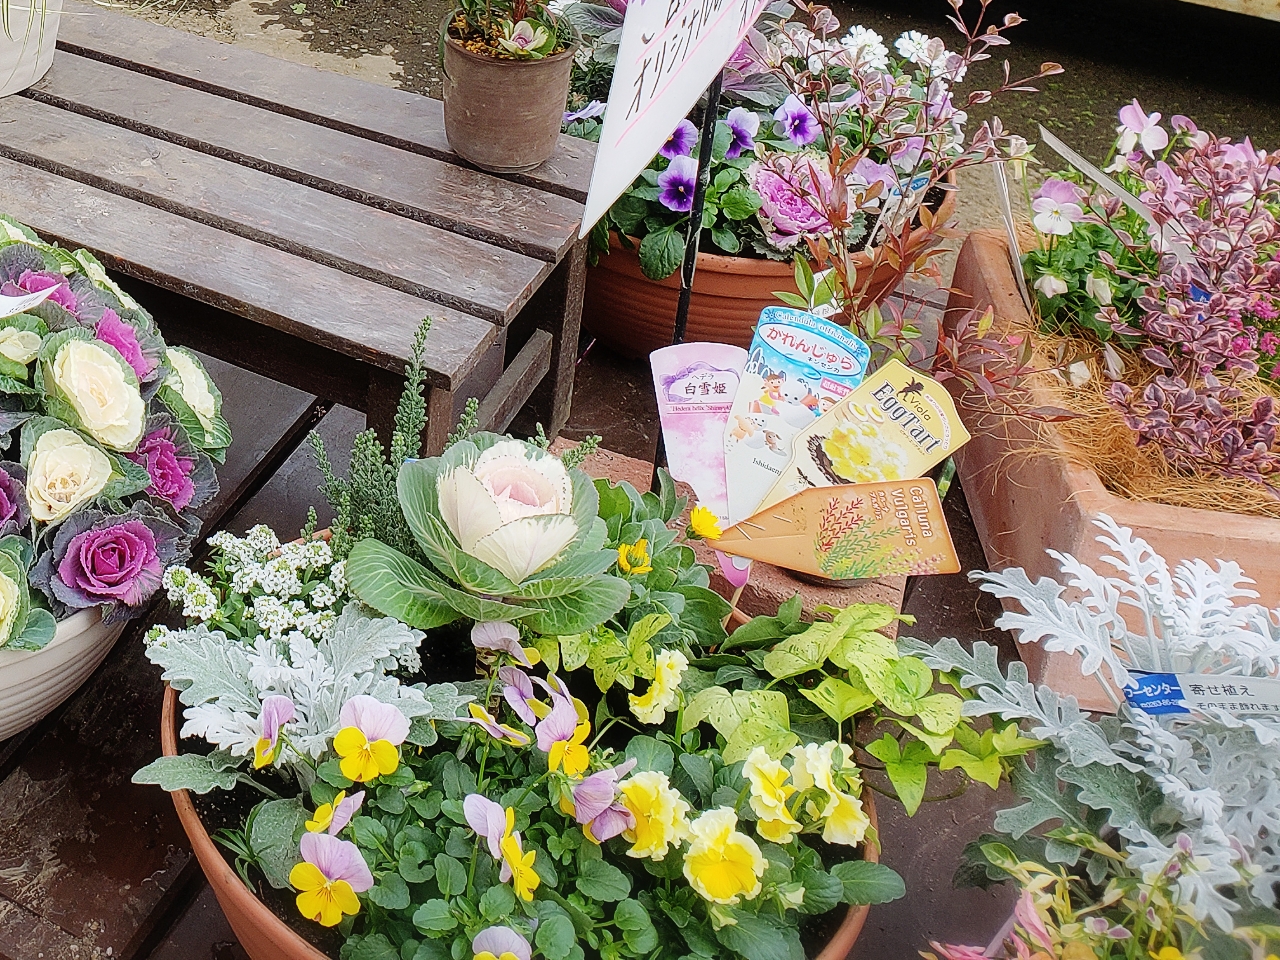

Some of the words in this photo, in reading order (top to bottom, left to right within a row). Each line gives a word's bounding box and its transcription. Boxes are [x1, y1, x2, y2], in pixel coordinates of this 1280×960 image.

[775, 311, 817, 328] Calendula
[807, 356, 840, 374] キンセンカ
[691, 372, 715, 380] ヘデラ
[684, 381, 728, 395] 白雪姫
[910, 395, 931, 421] Viola
[871, 381, 941, 454] EggTart
[891, 488, 917, 546] Vulgaris
[909, 486, 933, 538] Calluna
[1123, 682, 1181, 698] ワーセンター
[1188, 683, 1255, 697] 寄せ植え
